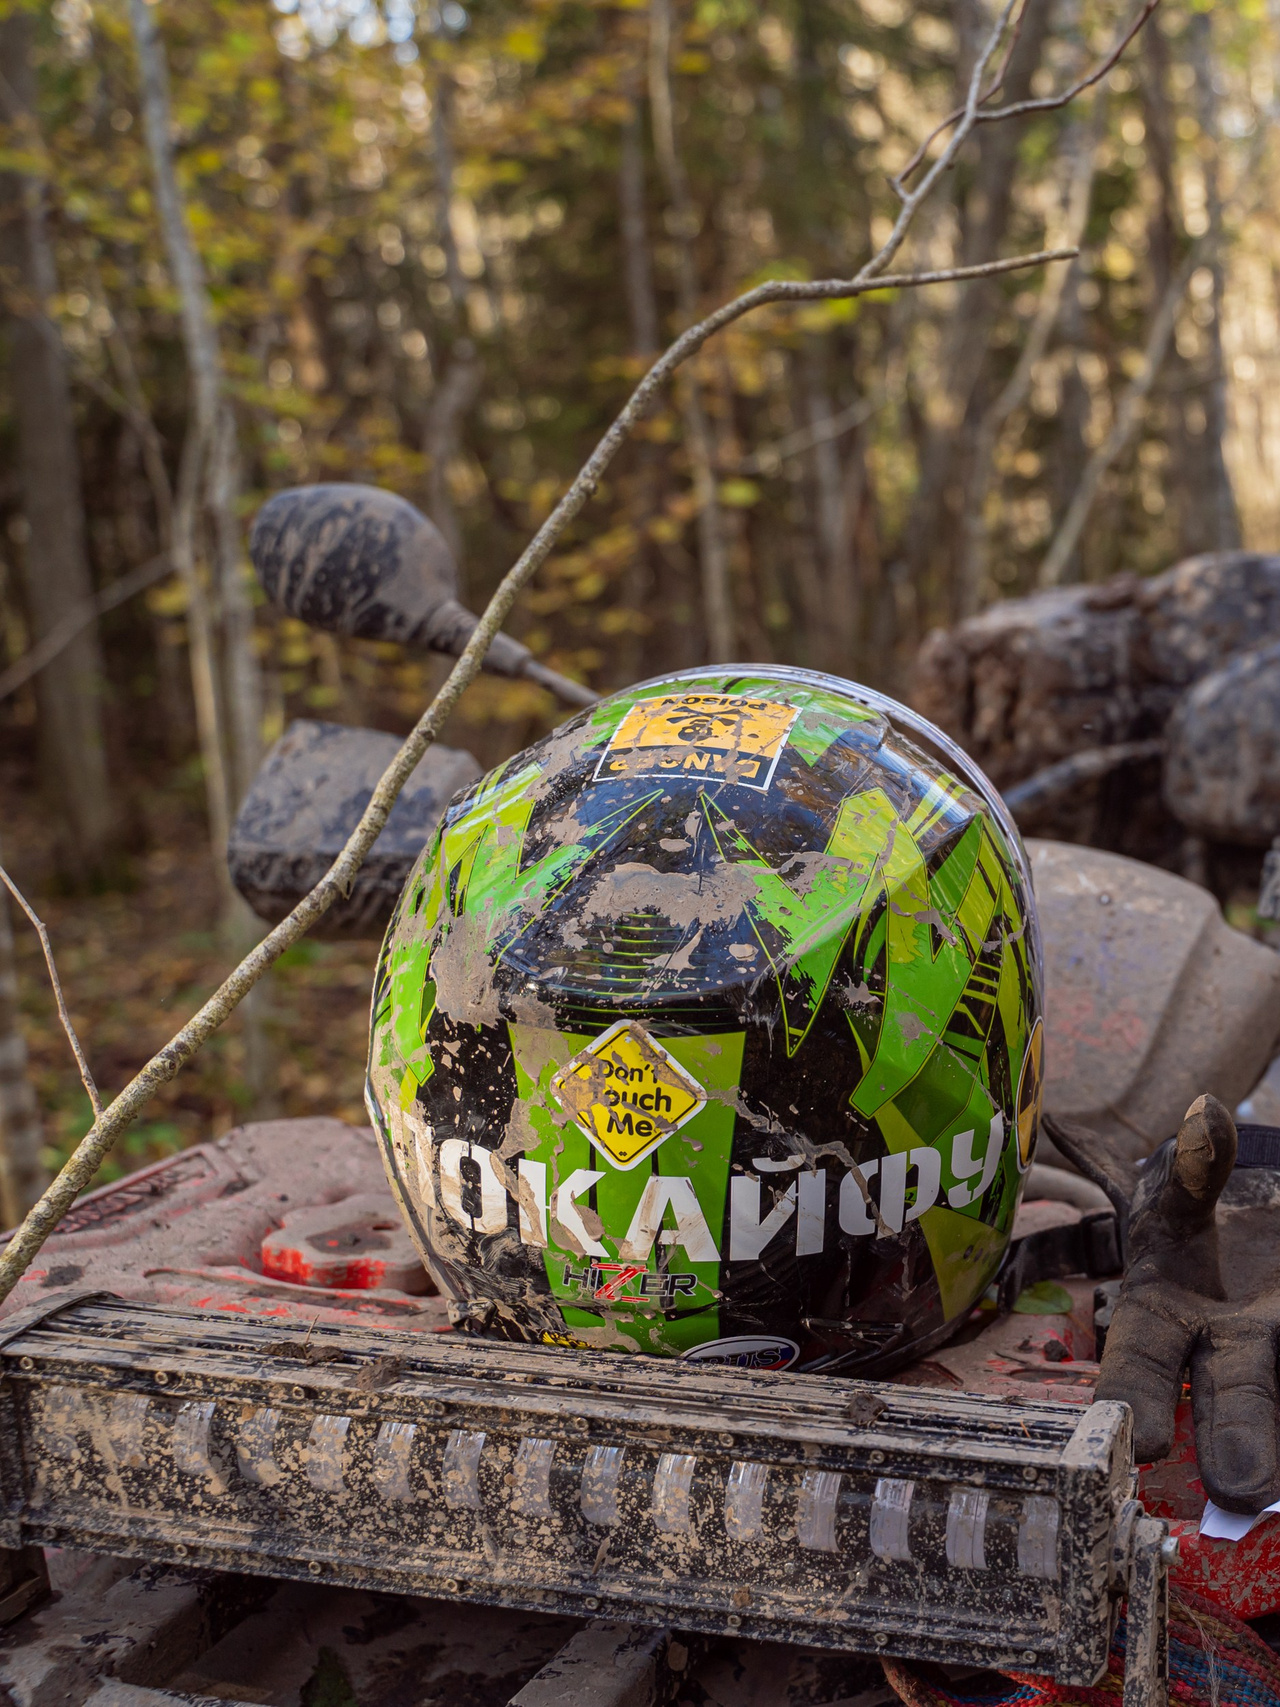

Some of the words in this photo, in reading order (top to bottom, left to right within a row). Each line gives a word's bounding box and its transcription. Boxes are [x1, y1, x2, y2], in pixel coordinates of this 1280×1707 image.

[661, 696, 768, 711] POISON
[606, 1111, 654, 1137] Me
[562, 1262, 698, 1304] HIZER
